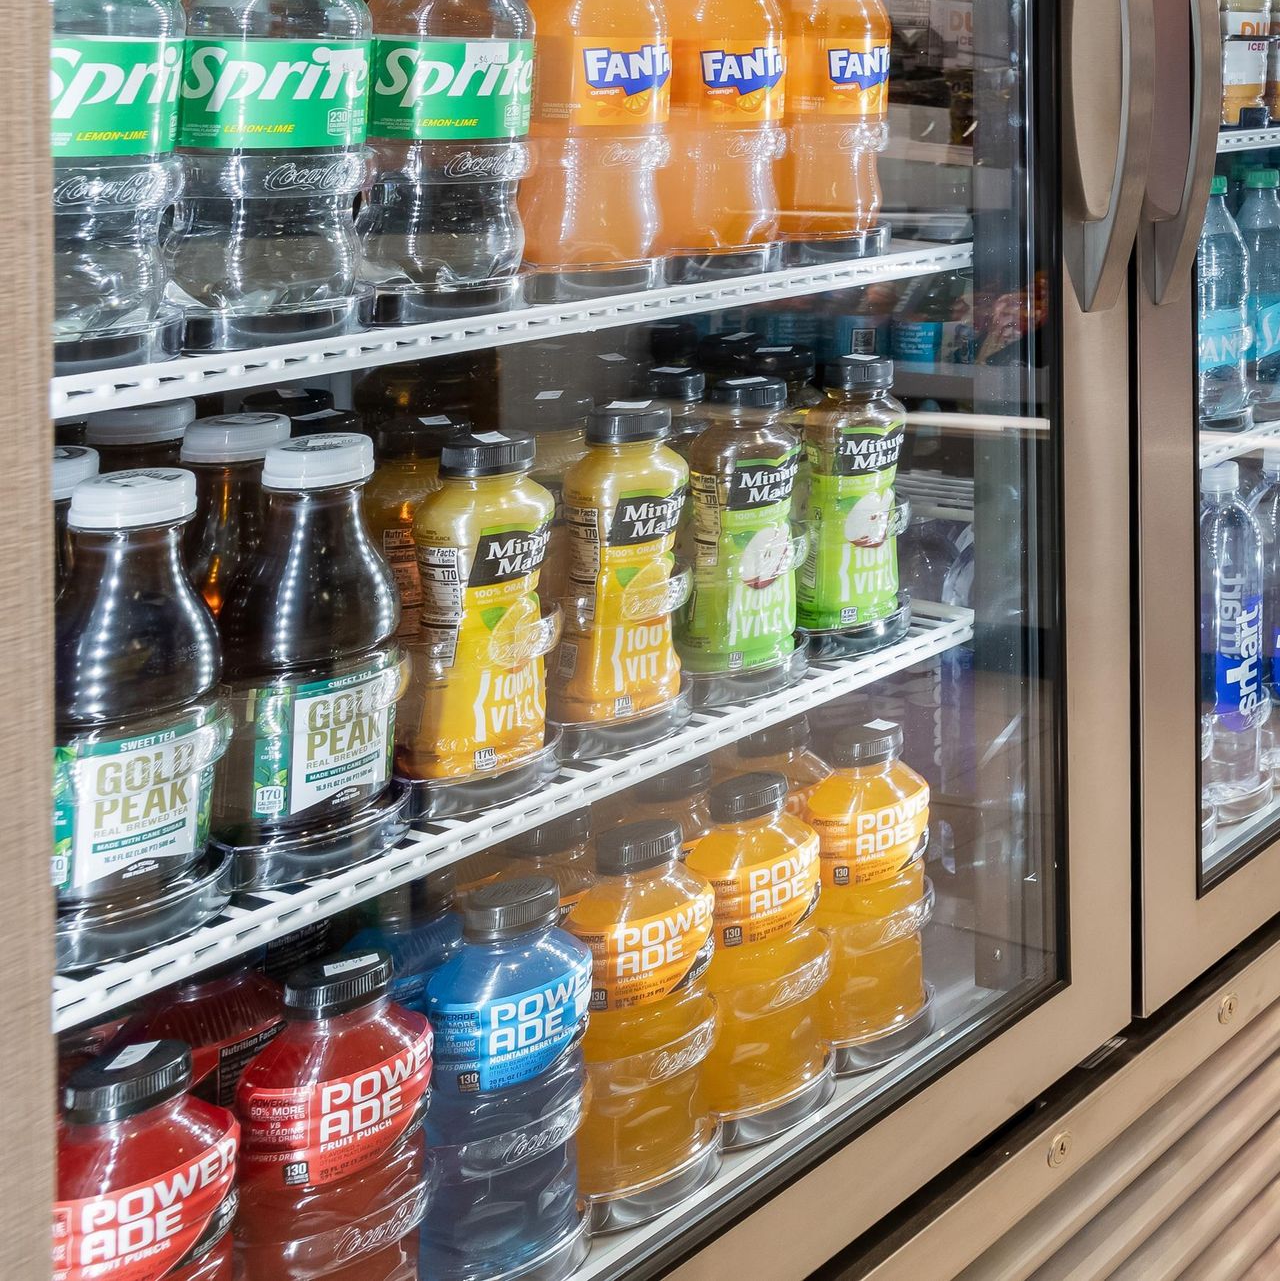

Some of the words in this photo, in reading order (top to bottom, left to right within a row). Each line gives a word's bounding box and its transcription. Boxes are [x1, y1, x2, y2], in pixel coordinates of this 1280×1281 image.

[375, 42, 534, 108] Sprite
[585, 44, 672, 82] FANTA
[703, 46, 784, 81] FANTA
[184, 45, 367, 112] Sprite
[590, 88, 620, 97] orange
[224, 123, 295, 135] LEMON-LIME
[417, 117, 479, 128] LEMON-LIME
[76, 129, 149, 142] LEMON-LIME
[852, 449, 899, 471] Maid
[748, 481, 793, 504] Maid
[584, 528, 598, 539] 170
[630, 515, 680, 540] Maid
[495, 547, 546, 578] Maid
[441, 569, 458, 581] 170
[474, 588, 499, 598] 100%
[120, 737, 153, 752] SWEET
[156, 730, 176, 743] TEA
[306, 716, 383, 761] PEAK
[306, 757, 331, 769] REAL
[333, 746, 368, 764] BREWED
[96, 743, 197, 797] GOLD
[93, 777, 191, 830] PEAK
[259, 788, 281, 801] 170
[126, 813, 170, 833] BREWED
[856, 824, 914, 856] ADE
[835, 868, 848, 878] 130
[749, 869, 809, 914] ADE
[725, 927, 740, 939] 130
[616, 935, 684, 977] ADE
[489, 1006, 564, 1057] ADE
[222, 1037, 258, 1057] Nutrition
[489, 1048, 529, 1065] MOUNTAIN
[529, 1039, 552, 1053] BERRY
[459, 1073, 478, 1085] 130
[272, 1105, 305, 1116] MORE
[319, 1085, 403, 1143] ADE
[319, 1135, 354, 1153] FRUIT
[356, 1118, 392, 1141] PUNCH
[285, 1162, 307, 1176] 130
[81, 1138, 237, 1235] POWER
[80, 1203, 184, 1266] ADE
[124, 1239, 171, 1264] PUNCH
